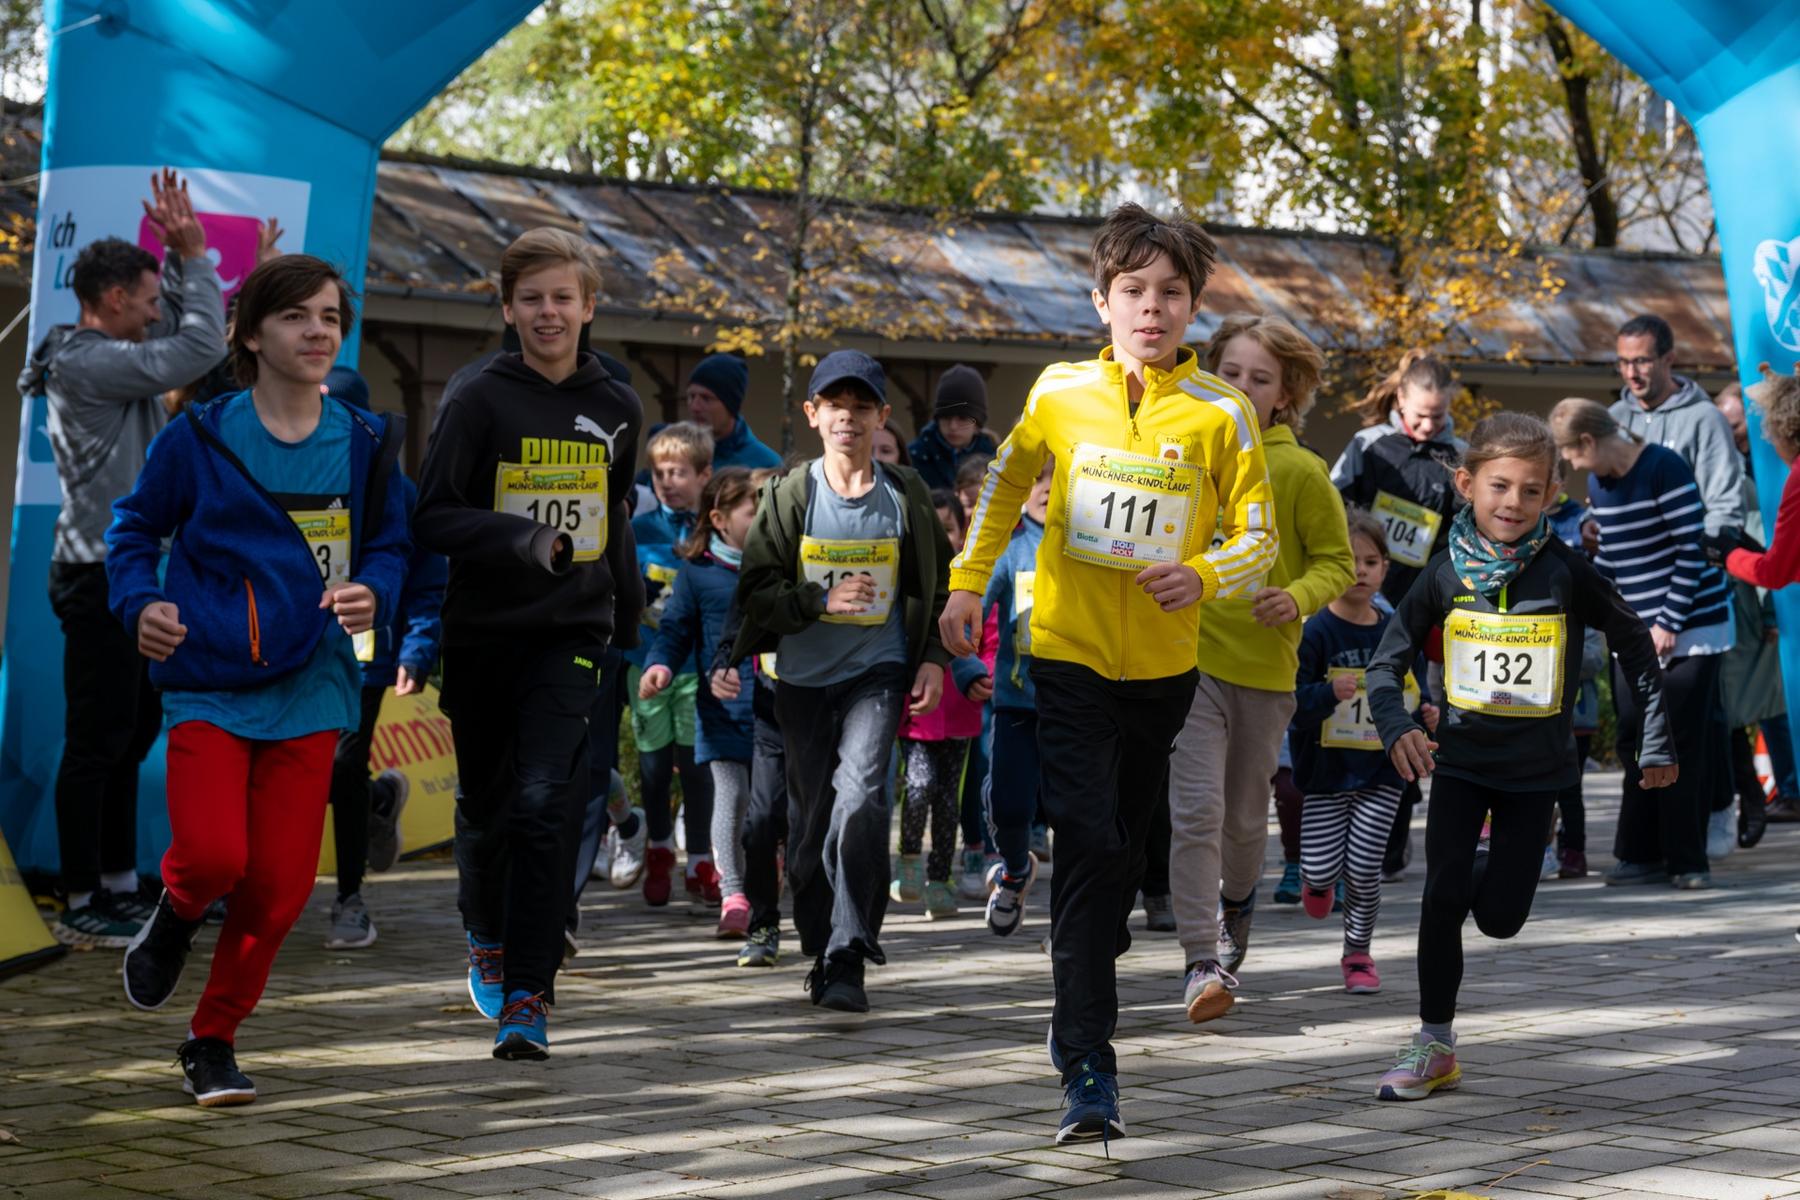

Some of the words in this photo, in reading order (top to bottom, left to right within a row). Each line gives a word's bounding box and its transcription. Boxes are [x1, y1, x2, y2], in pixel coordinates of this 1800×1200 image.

[47, 210, 76, 250] Ich
[1081, 465, 1191, 493] MÜNCHNER-KINDL-LAUF
[527, 499, 581, 531] 105
[1100, 491, 1158, 537] 111
[1077, 532, 1098, 544] Biotta
[1385, 516, 1418, 547] 104
[1111, 548, 1134, 557] MOLY
[1454, 629, 1554, 644] MÜNCHNER-KINDL-LAUF
[1473, 650, 1533, 685] 132
